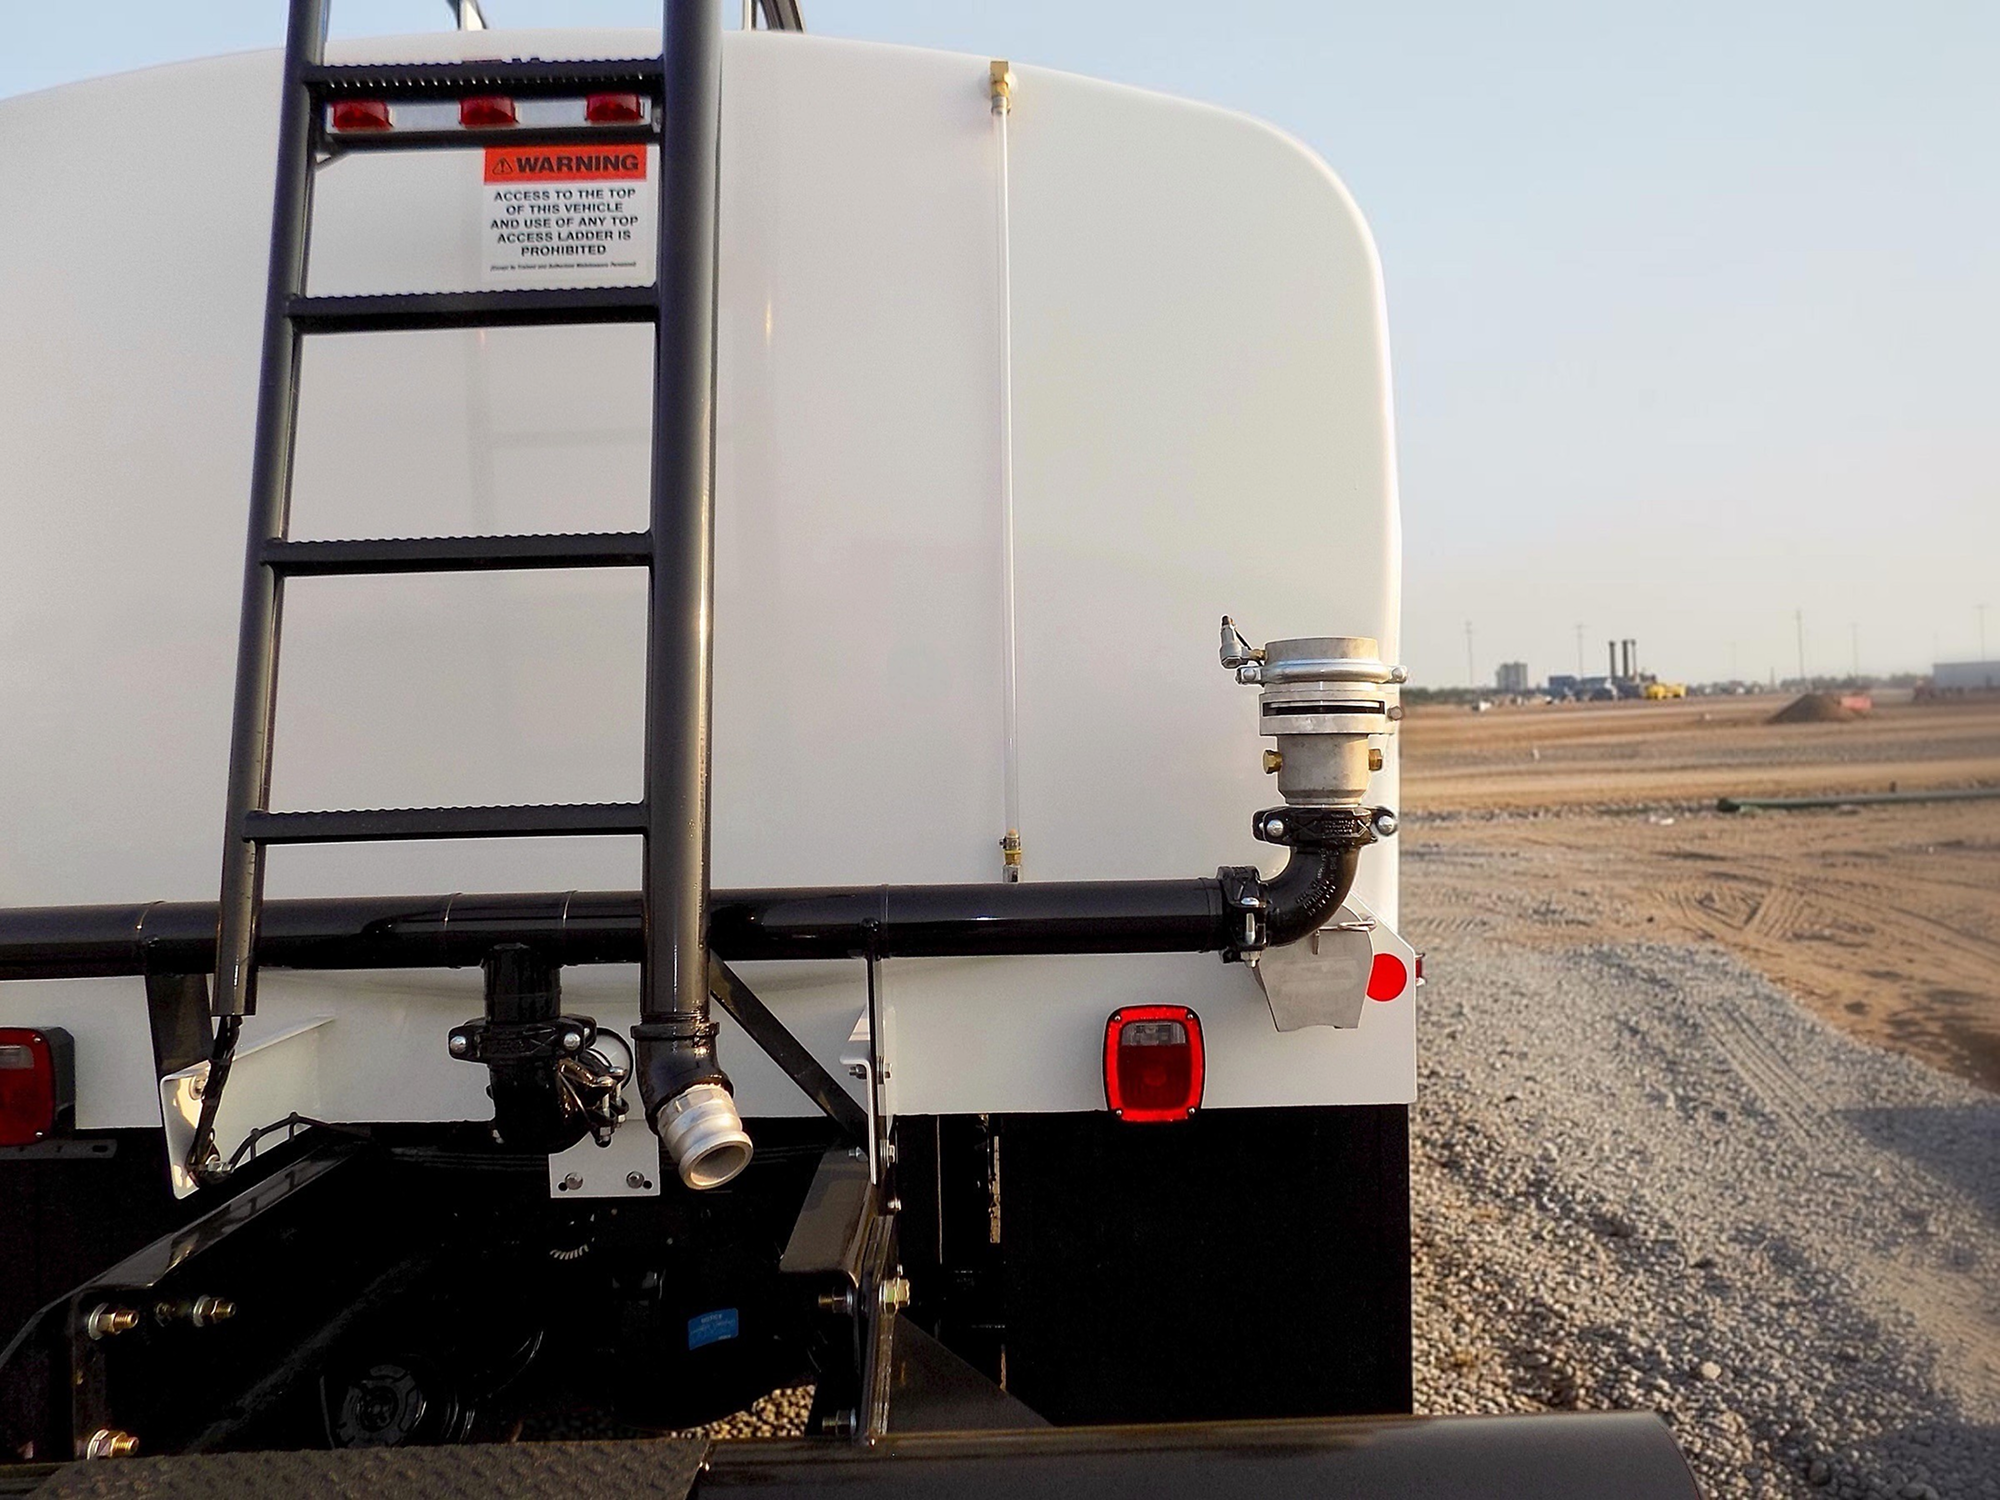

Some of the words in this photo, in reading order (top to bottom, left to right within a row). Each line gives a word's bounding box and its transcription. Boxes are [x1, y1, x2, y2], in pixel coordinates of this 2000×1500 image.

[516, 154, 638, 173] WARNING
[494, 190, 550, 202] ACCESS
[555, 189, 573, 200] TO
[578, 188, 604, 200] THE
[609, 188, 636, 199] TOP
[506, 205, 525, 215] OF
[529, 204, 560, 215] THIS
[564, 202, 623, 213] VEHICLE
[490, 219, 520, 230] AND
[524, 218, 551, 229] USE
[556, 217, 574, 228] OF
[579, 217, 606, 227] ANY
[611, 215, 638, 226] TOP
[497, 232, 553, 244] ACCESS
[557, 230, 613, 242] LADDER
[618, 229, 631, 240] IS
[521, 245, 606, 257] PROHIBITED
